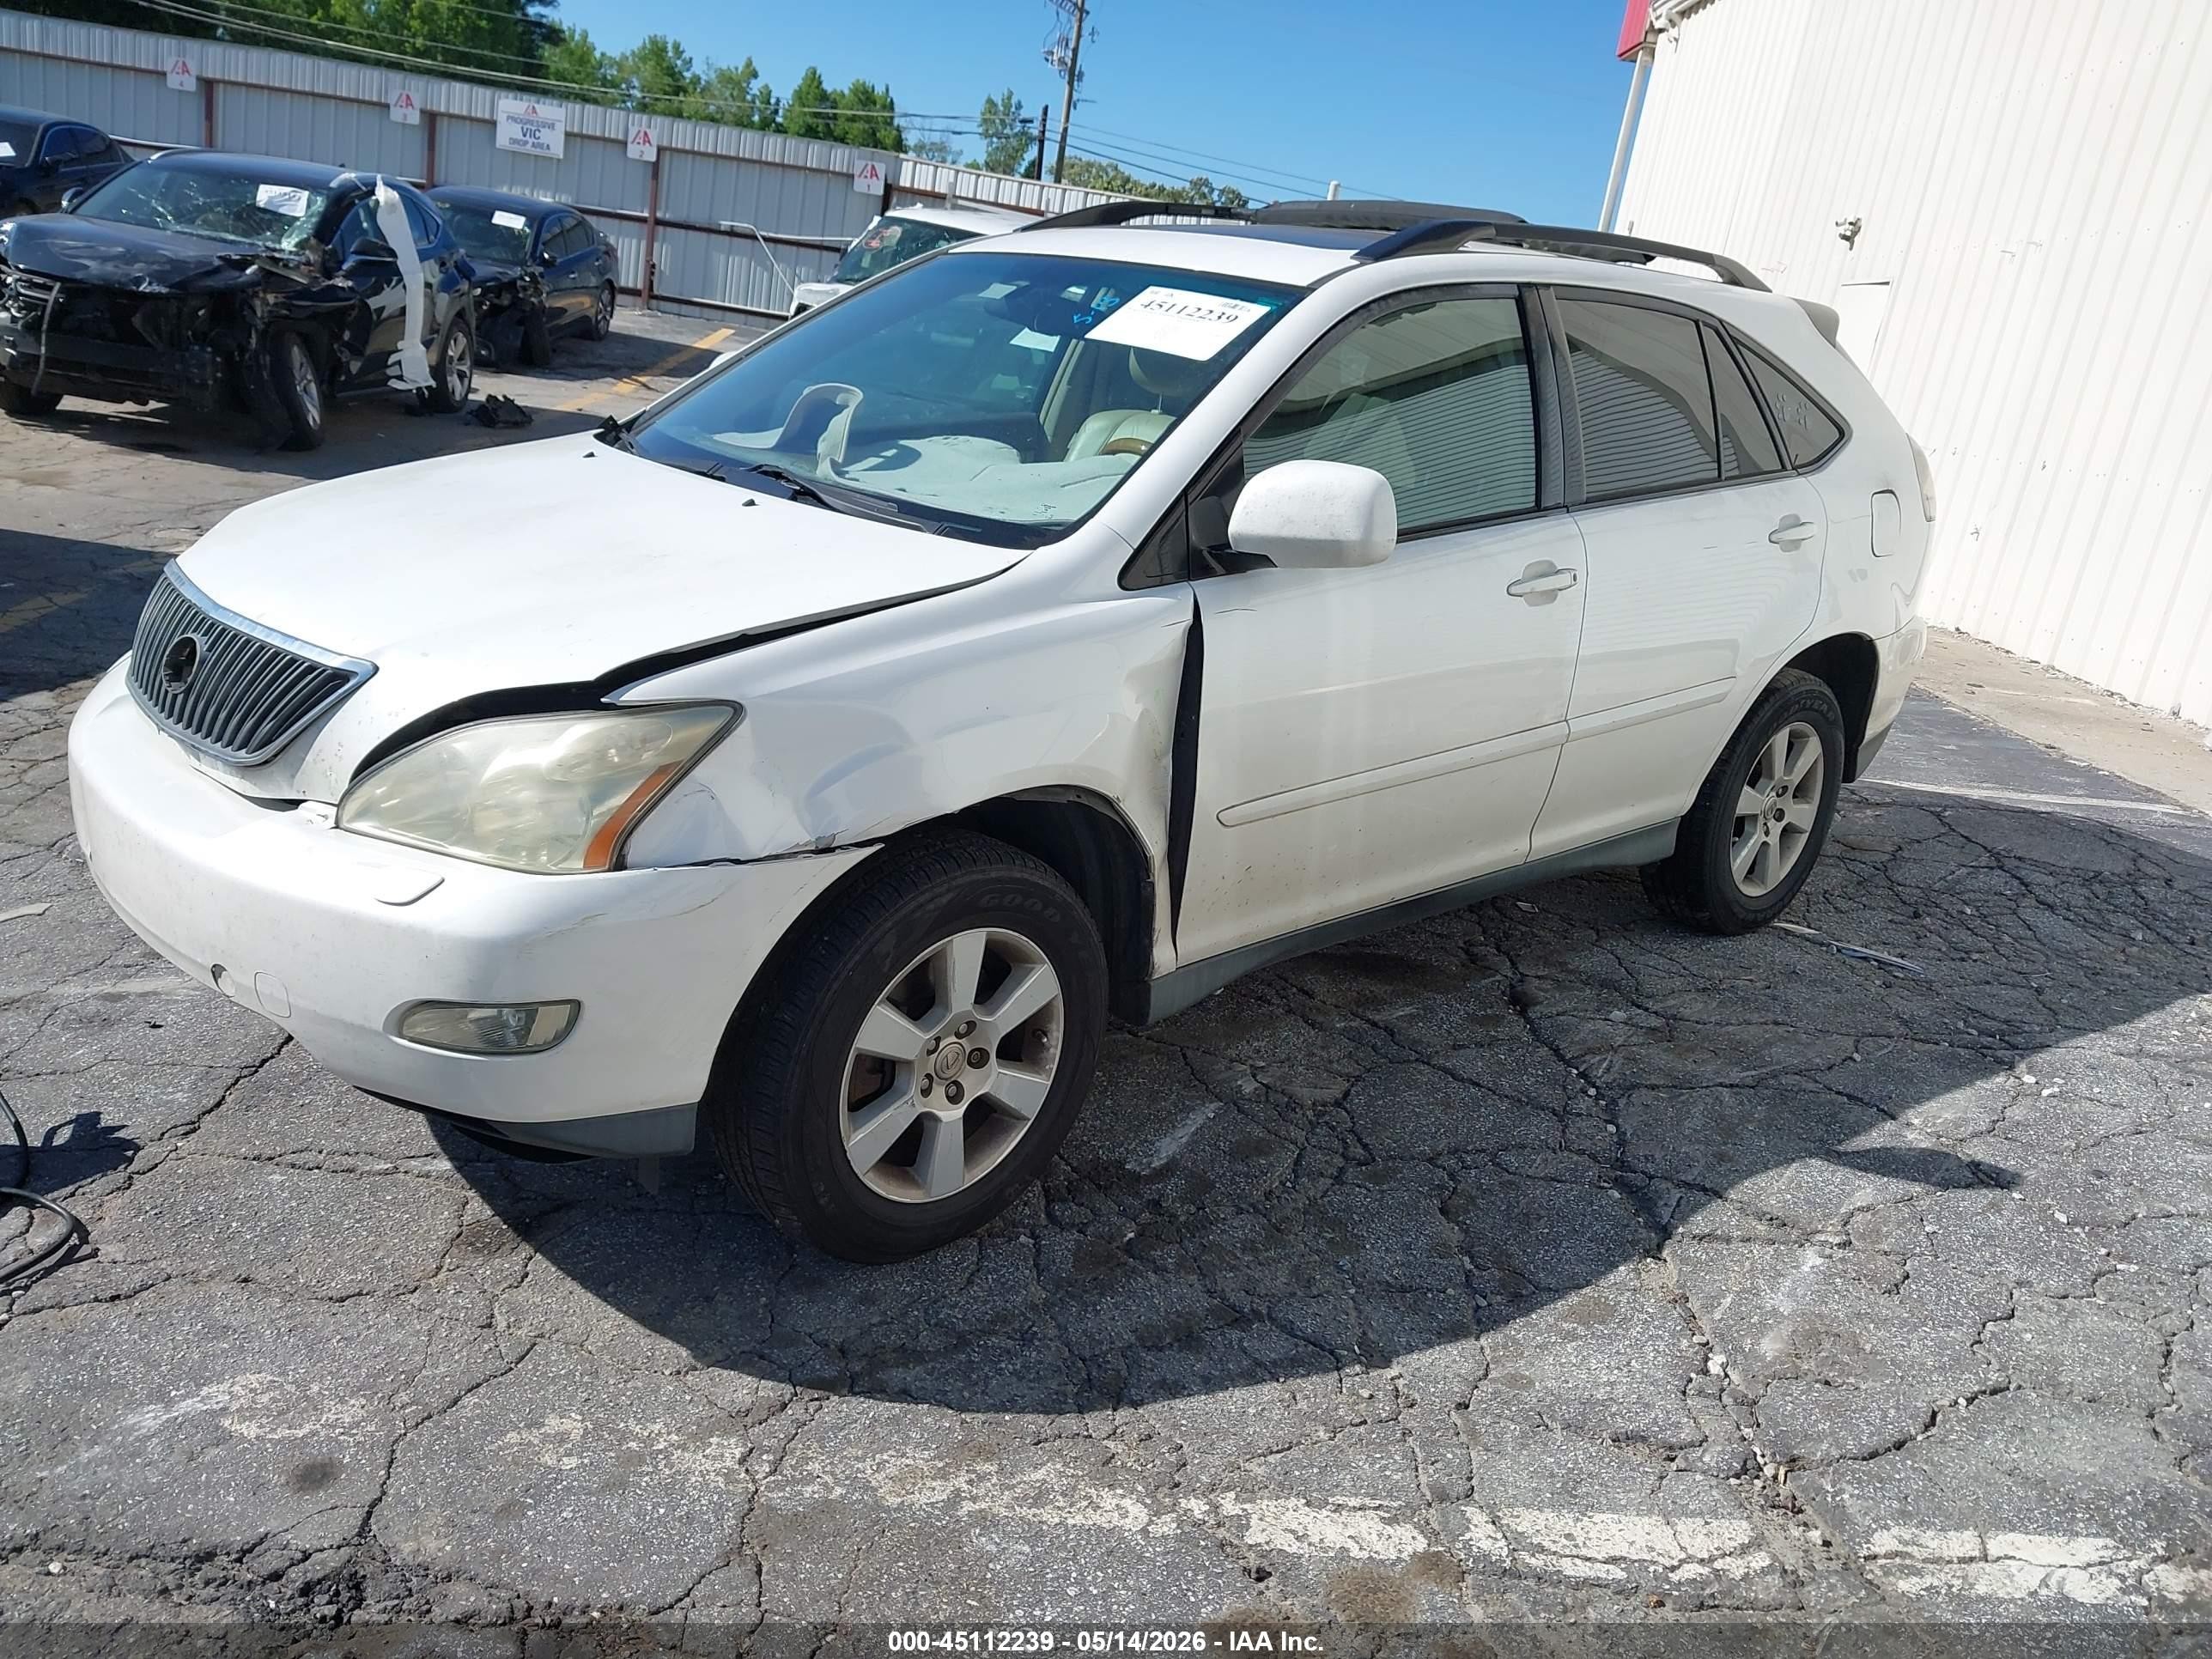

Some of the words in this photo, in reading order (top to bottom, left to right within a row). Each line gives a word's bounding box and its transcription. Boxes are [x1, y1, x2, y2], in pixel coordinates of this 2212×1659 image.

[506, 114, 556, 131] PROGRESSIVE
[520, 125, 542, 140] VIC
[508, 137, 529, 147] DROP
[531, 141, 550, 151] AREA
[1140, 299, 1239, 324] 45112239
